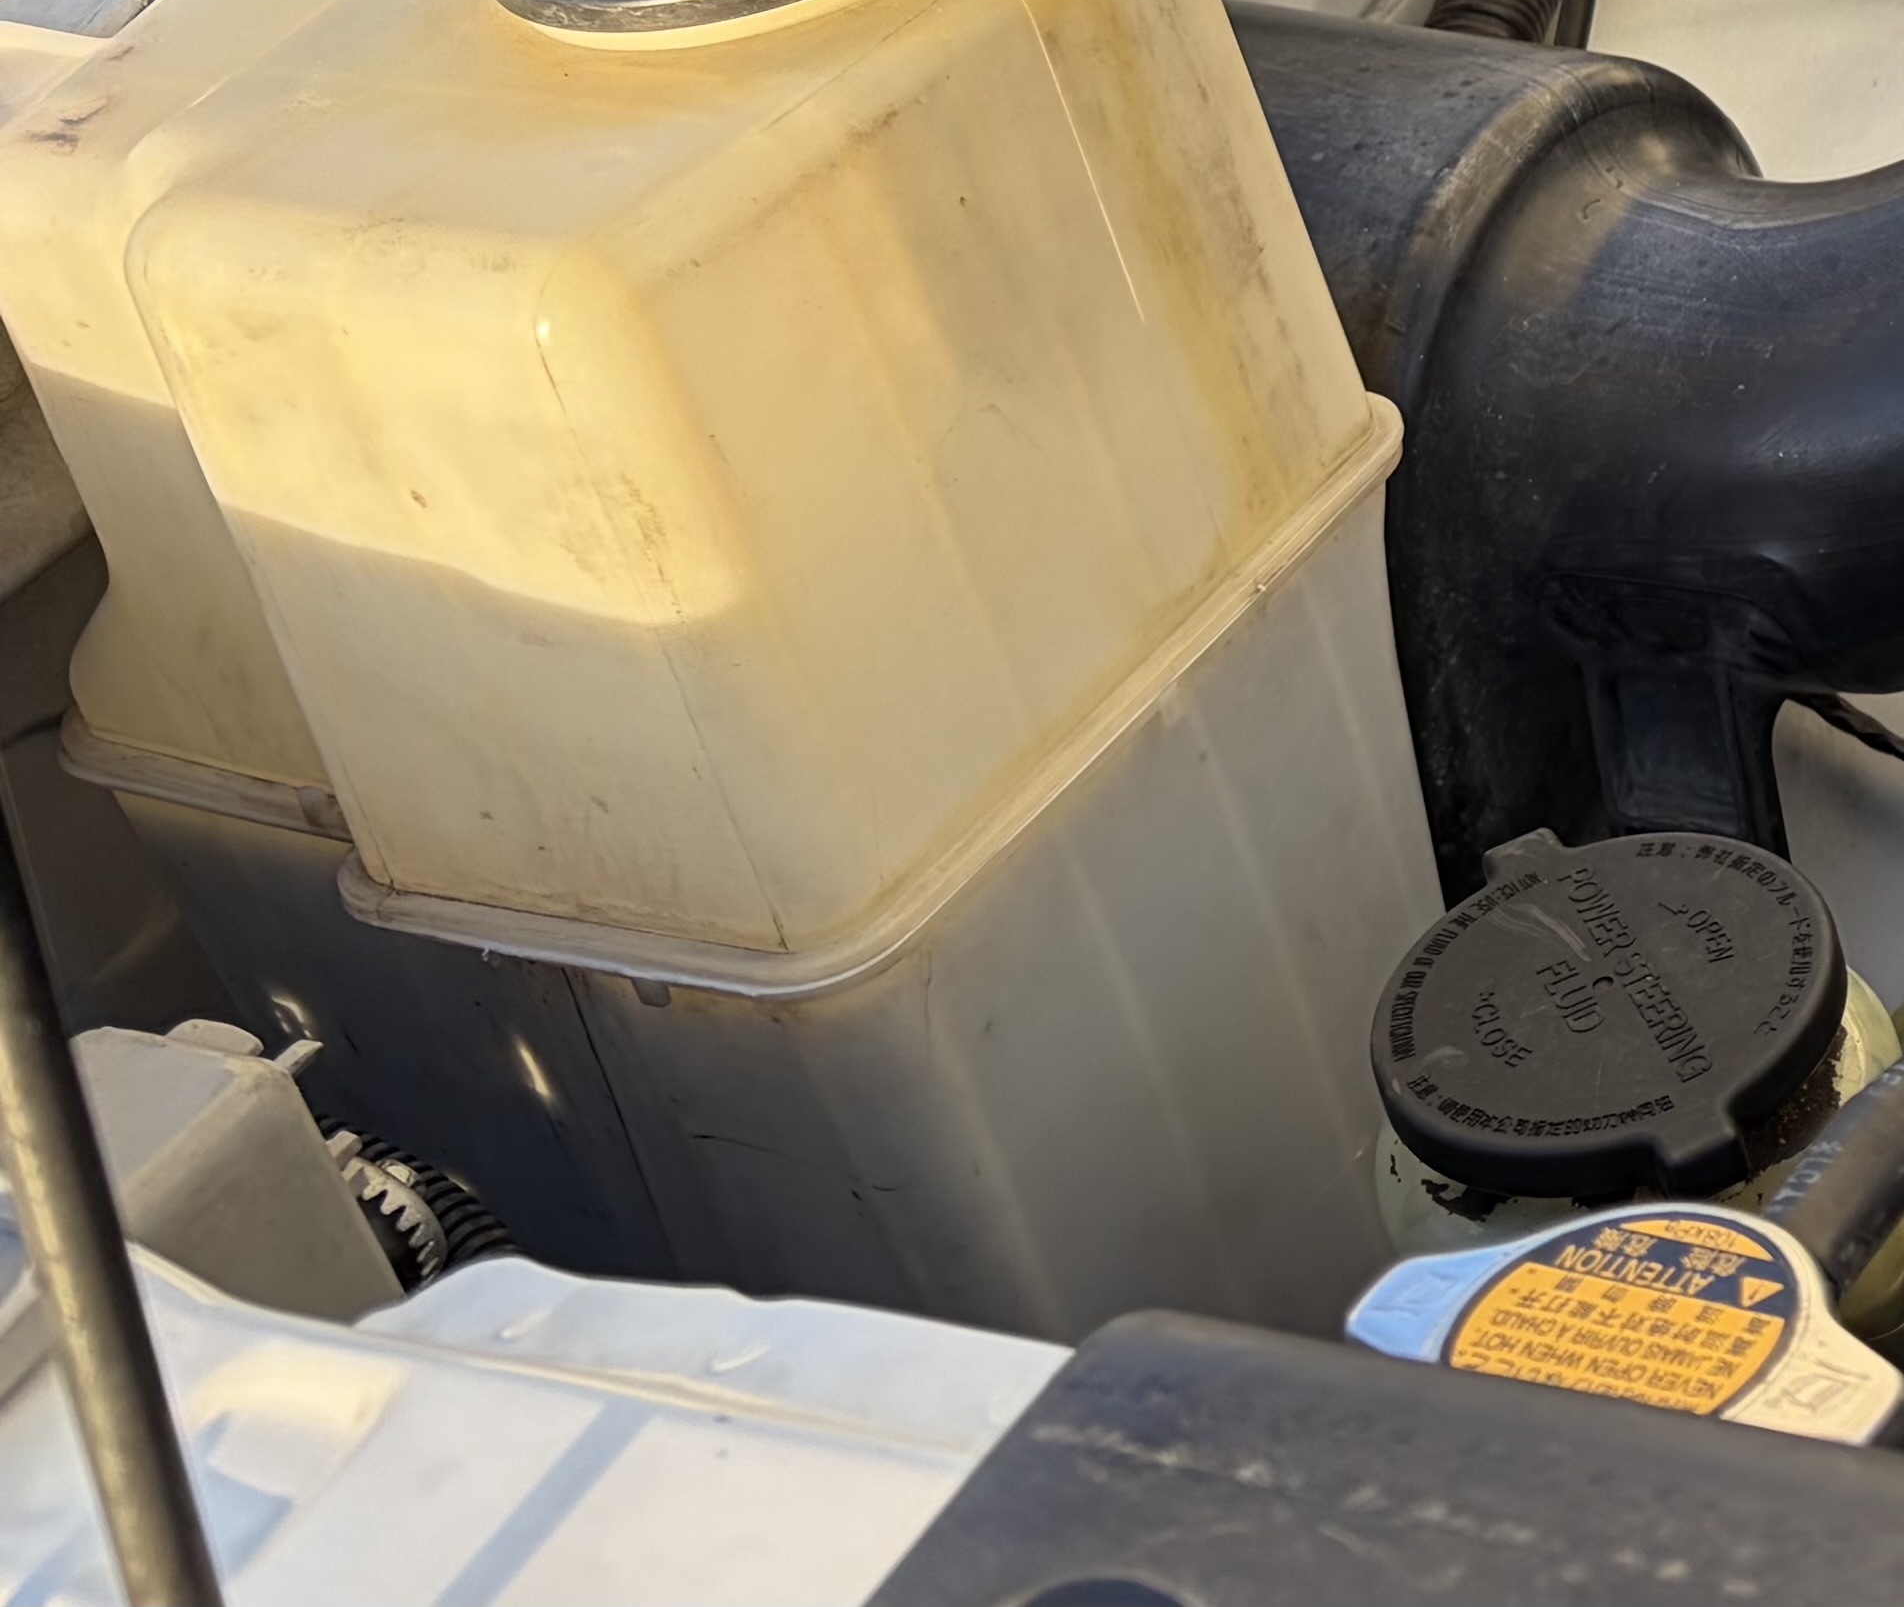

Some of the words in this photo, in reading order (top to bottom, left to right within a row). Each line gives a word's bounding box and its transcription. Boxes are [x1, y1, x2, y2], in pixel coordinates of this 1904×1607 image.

[1447, 911, 1479, 931] THE
[1687, 909, 1735, 964] OPEN
[1422, 928, 1459, 956] FLUID
[1557, 867, 1637, 958] POWER
[1613, 952, 1713, 1084] STEERING
[1535, 960, 1605, 1034] FLUID
[1471, 1003, 1534, 1069] CLOSE
[1554, 1244, 1716, 1295] ATTENTION
[1523, 1337, 1586, 1372] WHEN
[1572, 1324, 1645, 1357] OUVRIR
[1645, 1337, 1712, 1371] JAMAIS
[1585, 1353, 1649, 1381] OPEN
[1649, 1365, 1726, 1400] NEVER
[1708, 1356, 1742, 1378] NE
